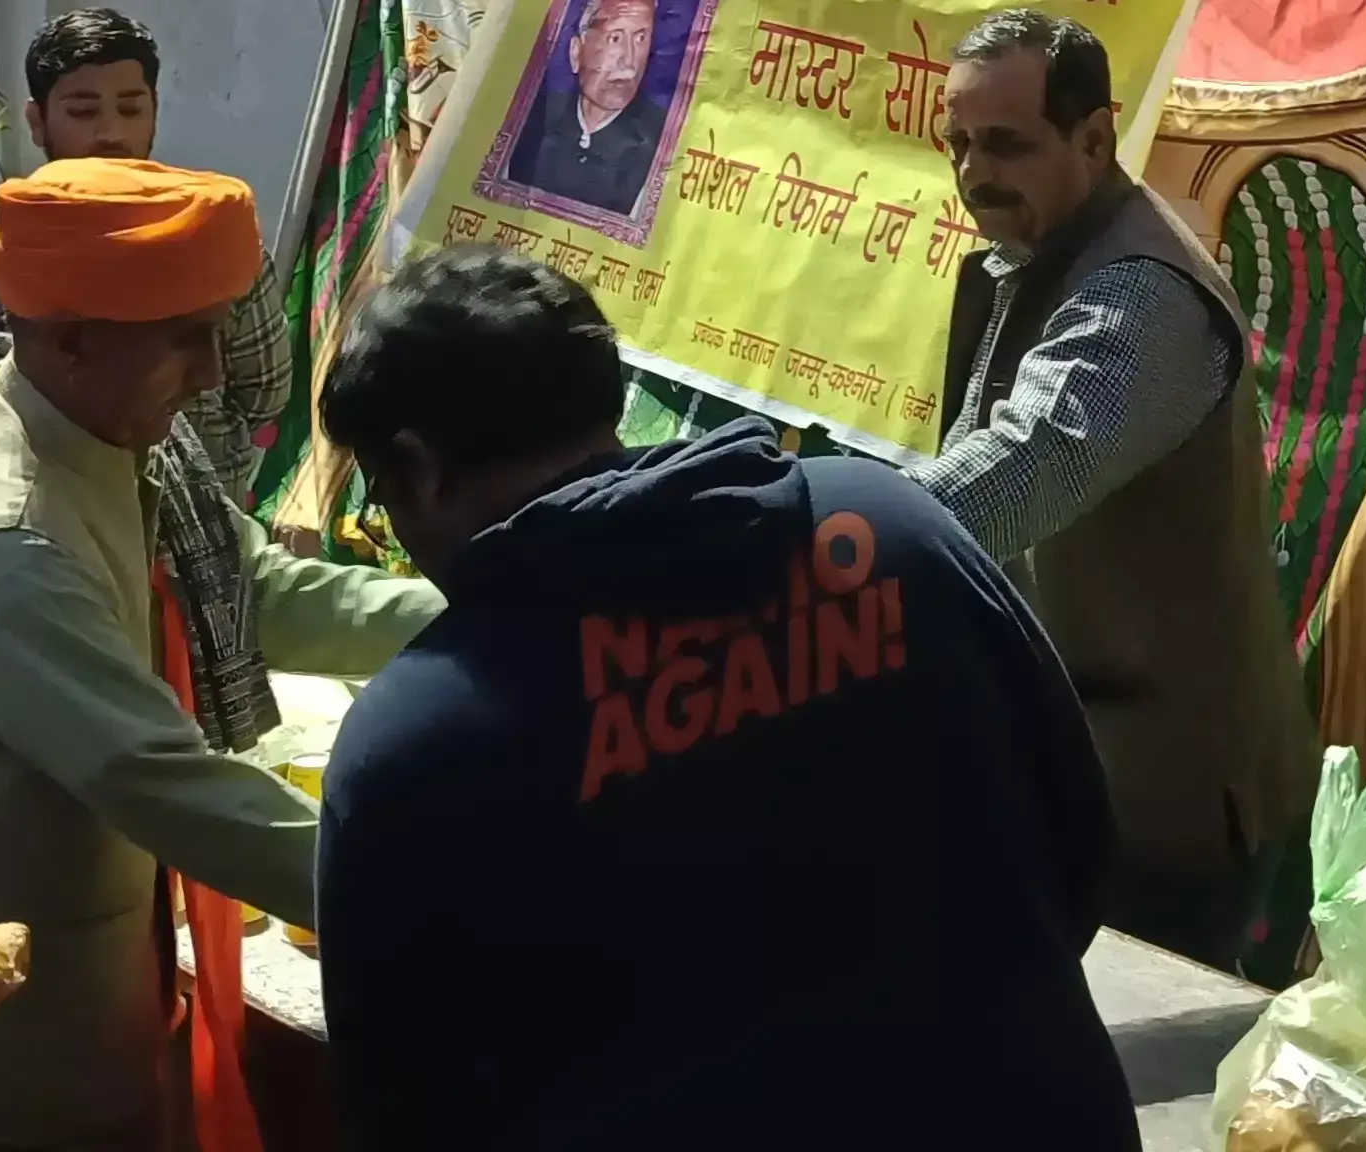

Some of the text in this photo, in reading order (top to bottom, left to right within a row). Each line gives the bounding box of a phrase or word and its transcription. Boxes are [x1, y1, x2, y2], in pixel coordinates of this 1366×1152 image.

[749, 20, 866, 120] मास्टर
[679, 128, 761, 217] सोशल
[761, 151, 868, 245] रिफार्म
[863, 188, 922, 265] एवं
[545, 227, 594, 280] सोहन
[595, 255, 631, 295] लाल
[631, 260, 672, 307] शर्मा
[729, 328, 780, 370] सरताज
[578, 576, 906, 802] AGAIN!
